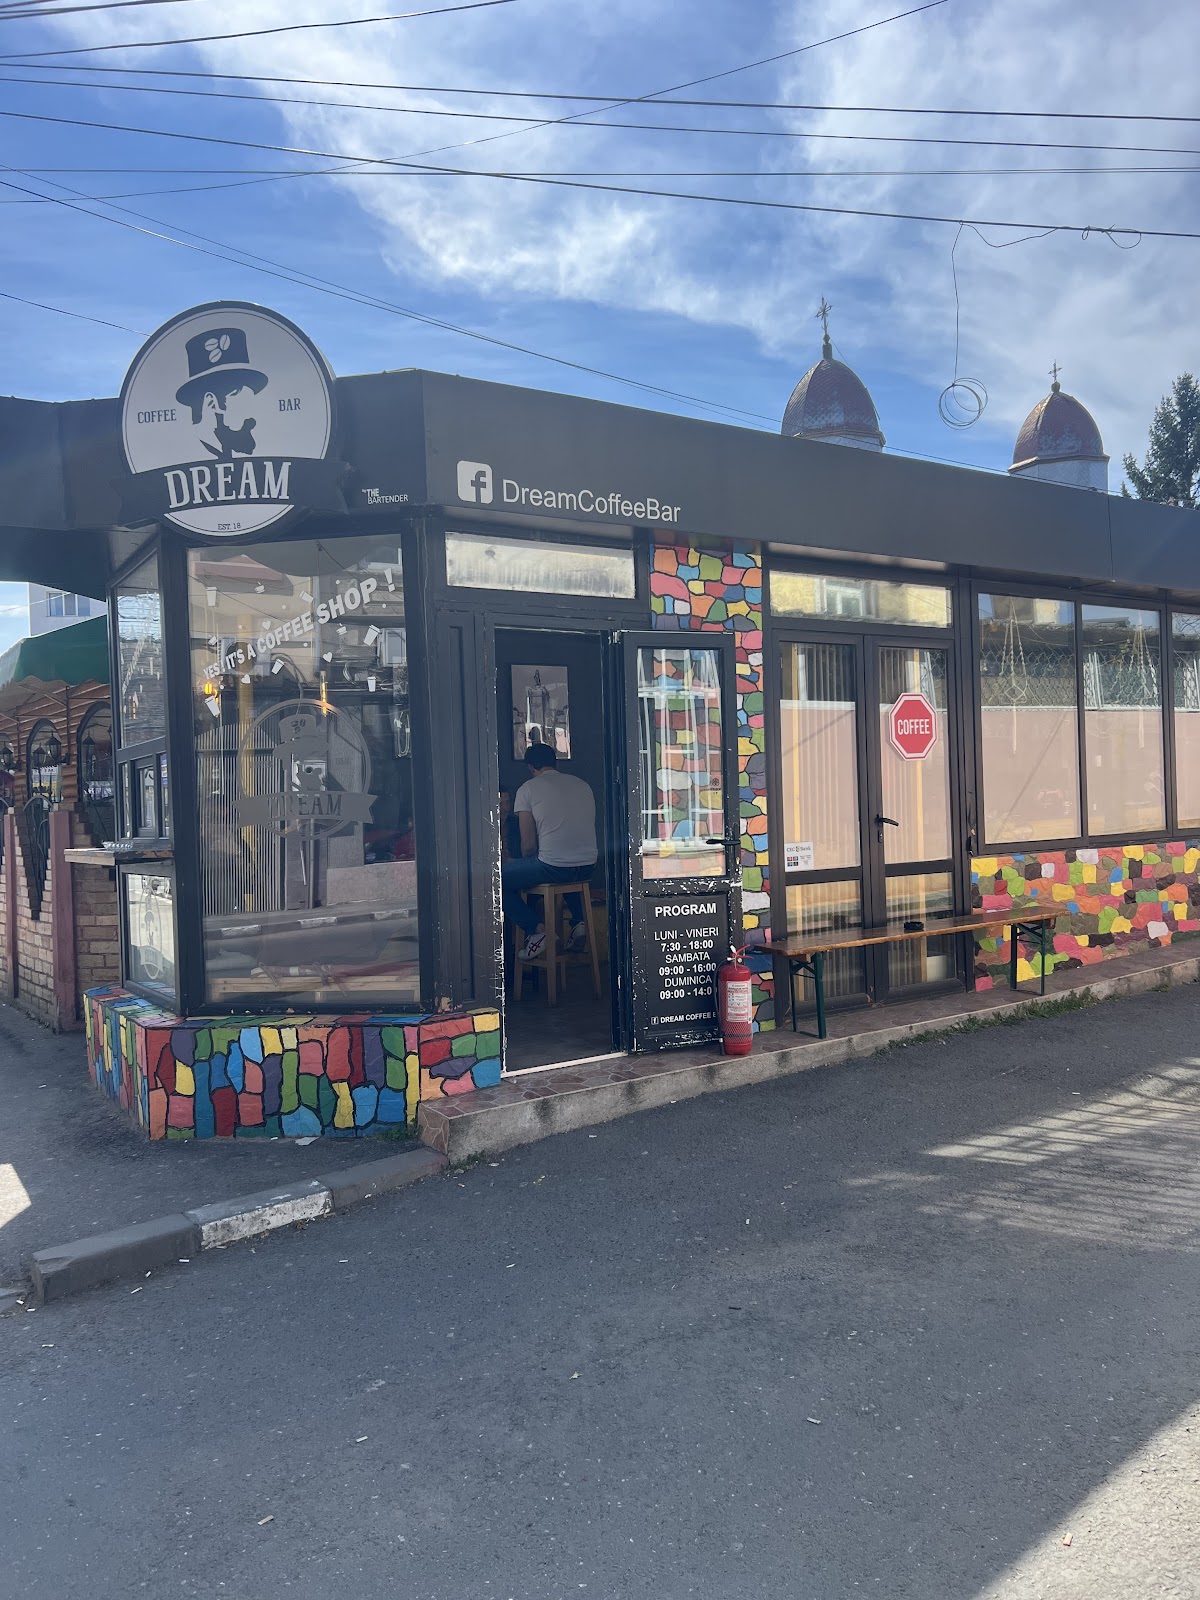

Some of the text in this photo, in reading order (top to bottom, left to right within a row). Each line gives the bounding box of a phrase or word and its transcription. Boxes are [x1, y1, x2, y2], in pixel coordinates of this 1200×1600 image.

[278, 398, 301, 412] BAR
[137, 408, 177, 424] COFFEE
[164, 461, 292, 509] DREAM
[367, 488, 380, 498] THE
[367, 494, 409, 505] BARTENDER
[502, 479, 681, 523] DreamCoffeeBar
[225, 648, 245, 670] IT'S
[246, 643, 257, 660] A
[256, 610, 315, 654] COFFEE
[316, 576, 378, 625] SHOP
[897, 718, 930, 735] COFFEE
[655, 903, 716, 917] PROGRAM
[654, 931, 678, 941] LUNI
[686, 927, 719, 938] VINERI
[661, 943, 681, 953] 7:30
[689, 940, 714, 950] 18:00
[665, 952, 711, 964] SAMBATA
[658, 966, 685, 977] 09:00
[692, 962, 716, 973] 16:00
[664, 975, 712, 987] DUMINICA
[659, 989, 685, 1000] 09:00
[693, 986, 717, 997] 14:0
[660, 1014, 685, 1024] DREAM
[685, 1011, 711, 1021] COFFEE
